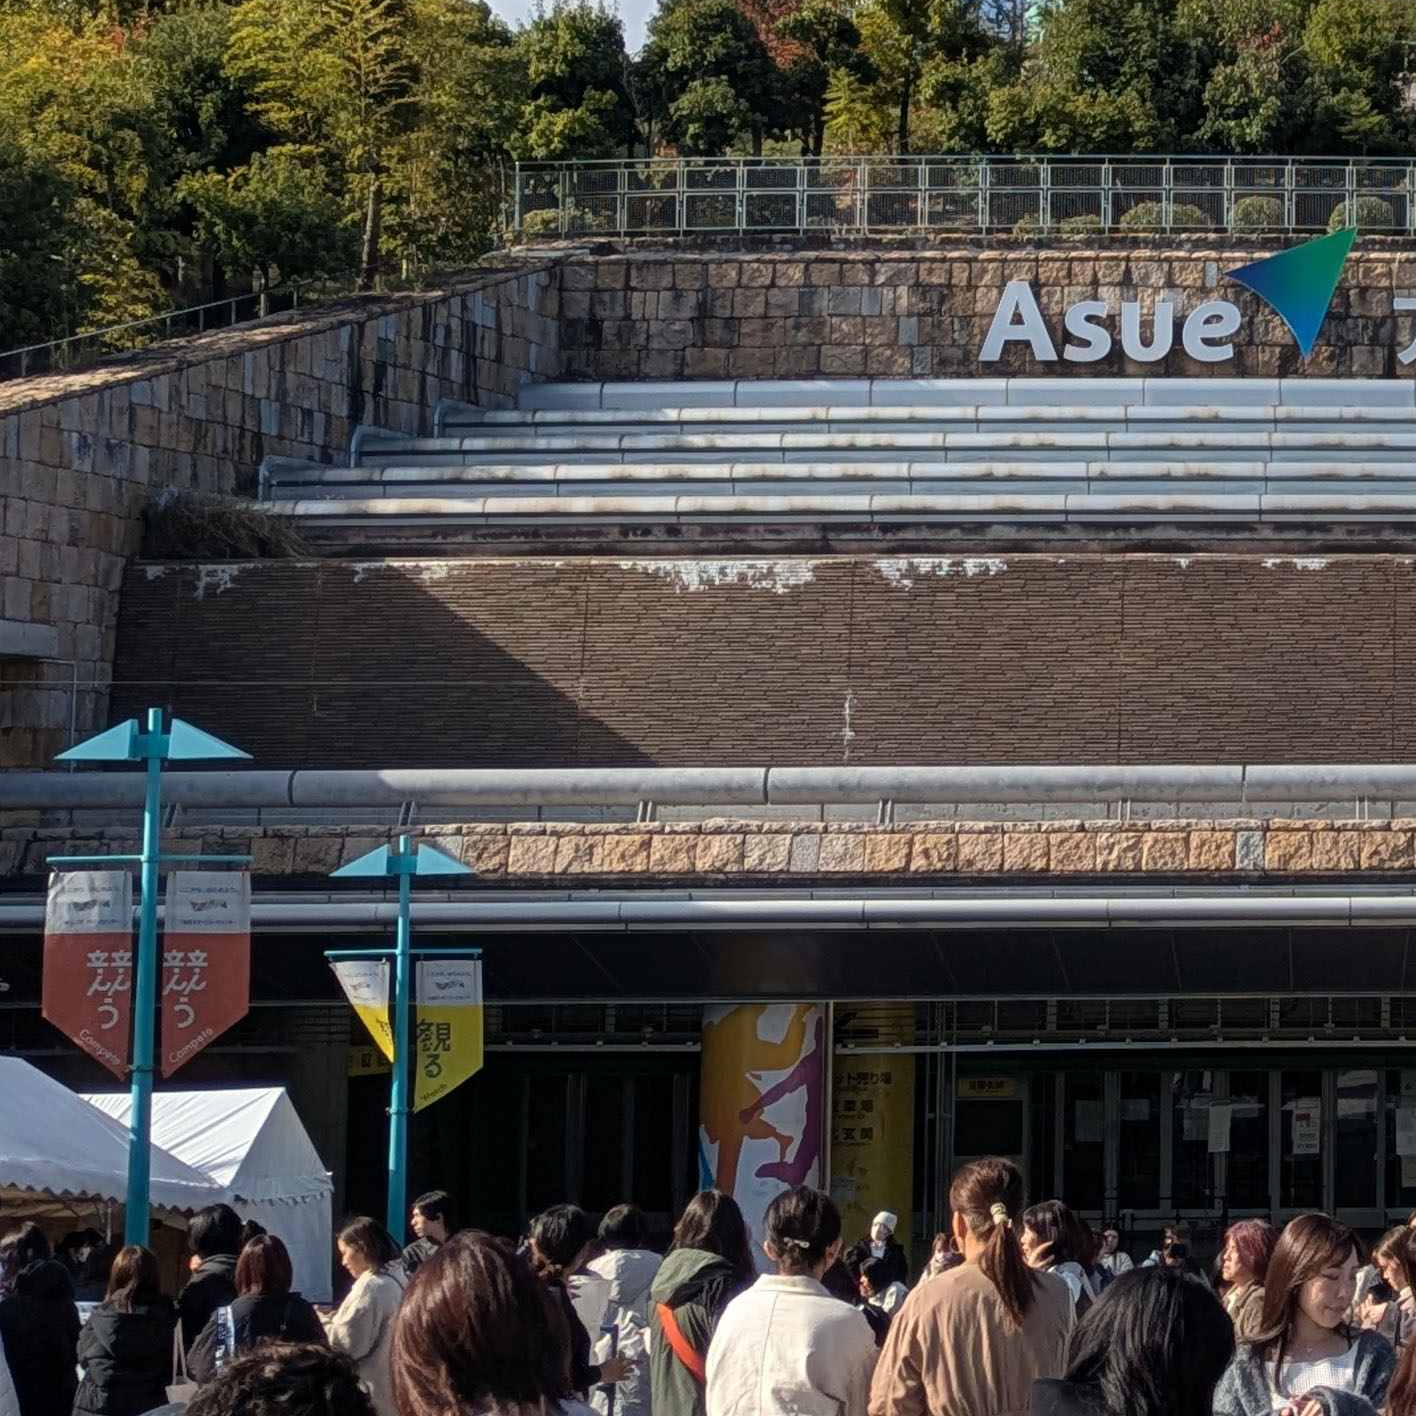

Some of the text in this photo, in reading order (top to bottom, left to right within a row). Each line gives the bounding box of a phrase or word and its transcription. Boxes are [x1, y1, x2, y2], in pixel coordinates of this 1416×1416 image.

[978, 281, 1242, 363] Asue
[78, 1028, 121, 1066] Compete
[169, 1027, 214, 1063] Compete
[416, 1018, 452, 1078] 観る
